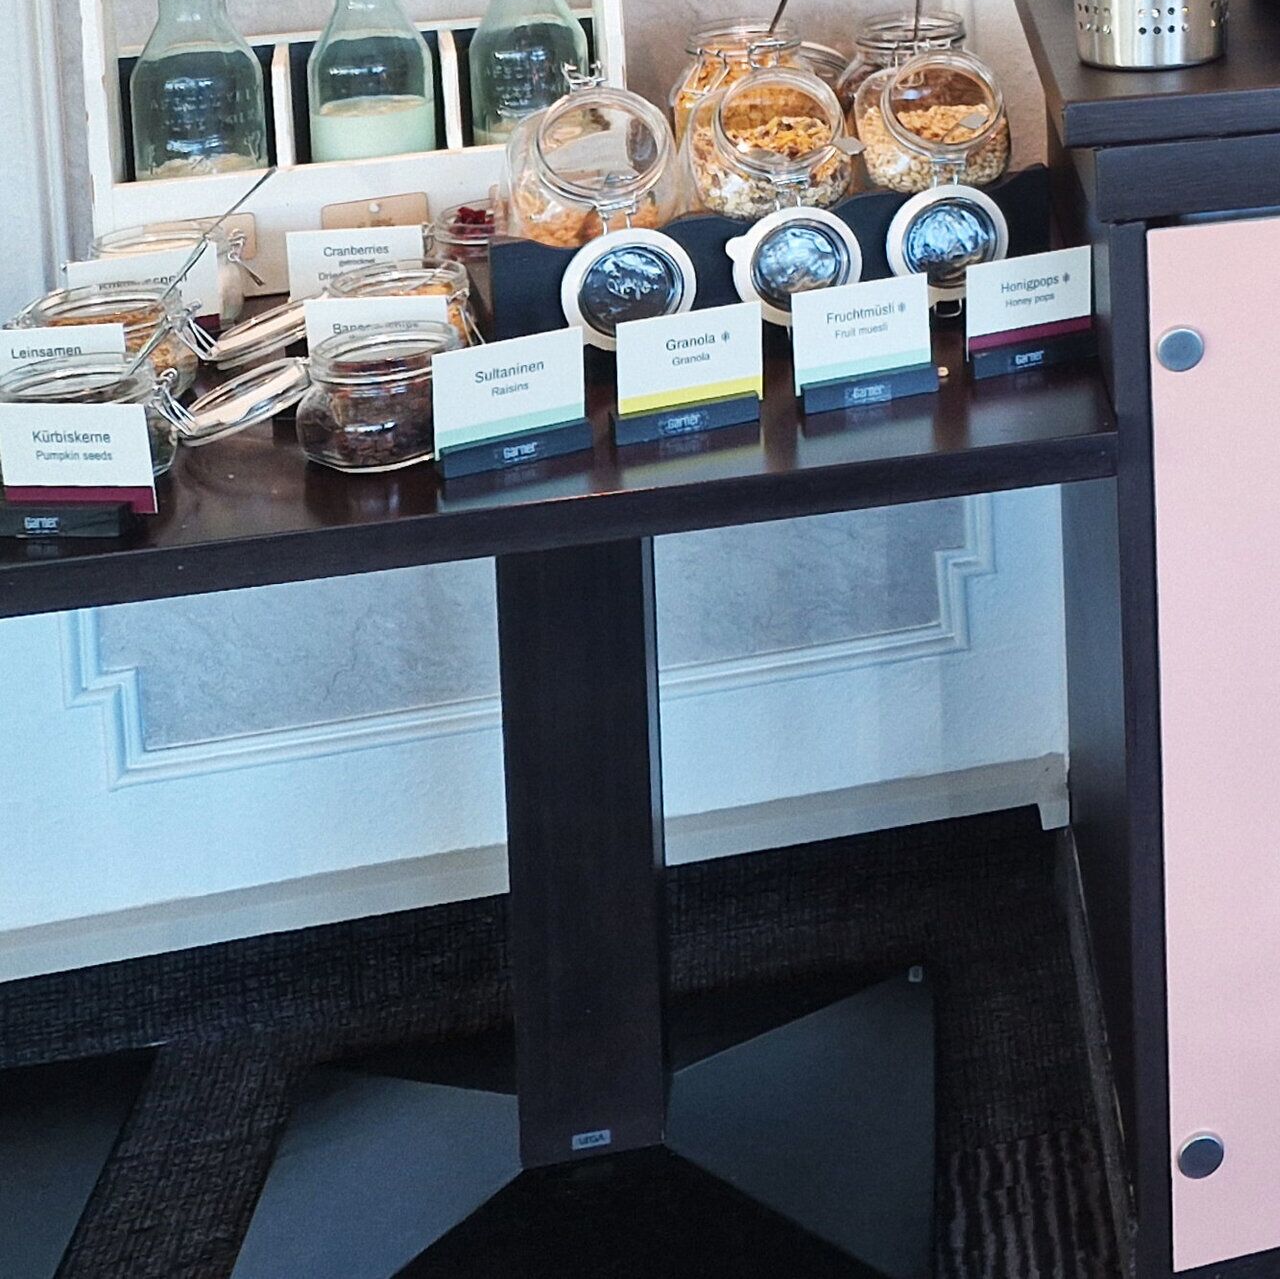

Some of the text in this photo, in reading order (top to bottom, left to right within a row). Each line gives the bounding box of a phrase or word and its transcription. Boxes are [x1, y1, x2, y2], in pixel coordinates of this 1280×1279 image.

[323, 245, 389, 257] Cranberries
[1001, 275, 1059, 293] Honigpops
[1005, 293, 1055, 308] Honey pops
[826, 302, 895, 324] Fruchtmüsli
[835, 322, 888, 339] Fruit muesli
[665, 333, 716, 352] Granola
[11, 346, 83, 359] Leinsamen
[671, 352, 710, 366] Granola
[474, 361, 545, 383] Sultaninen
[491, 381, 529, 396] Raisins
[32, 430, 111, 444] Kürbiskerne
[36, 450, 113, 462] Pumpkin seeds
